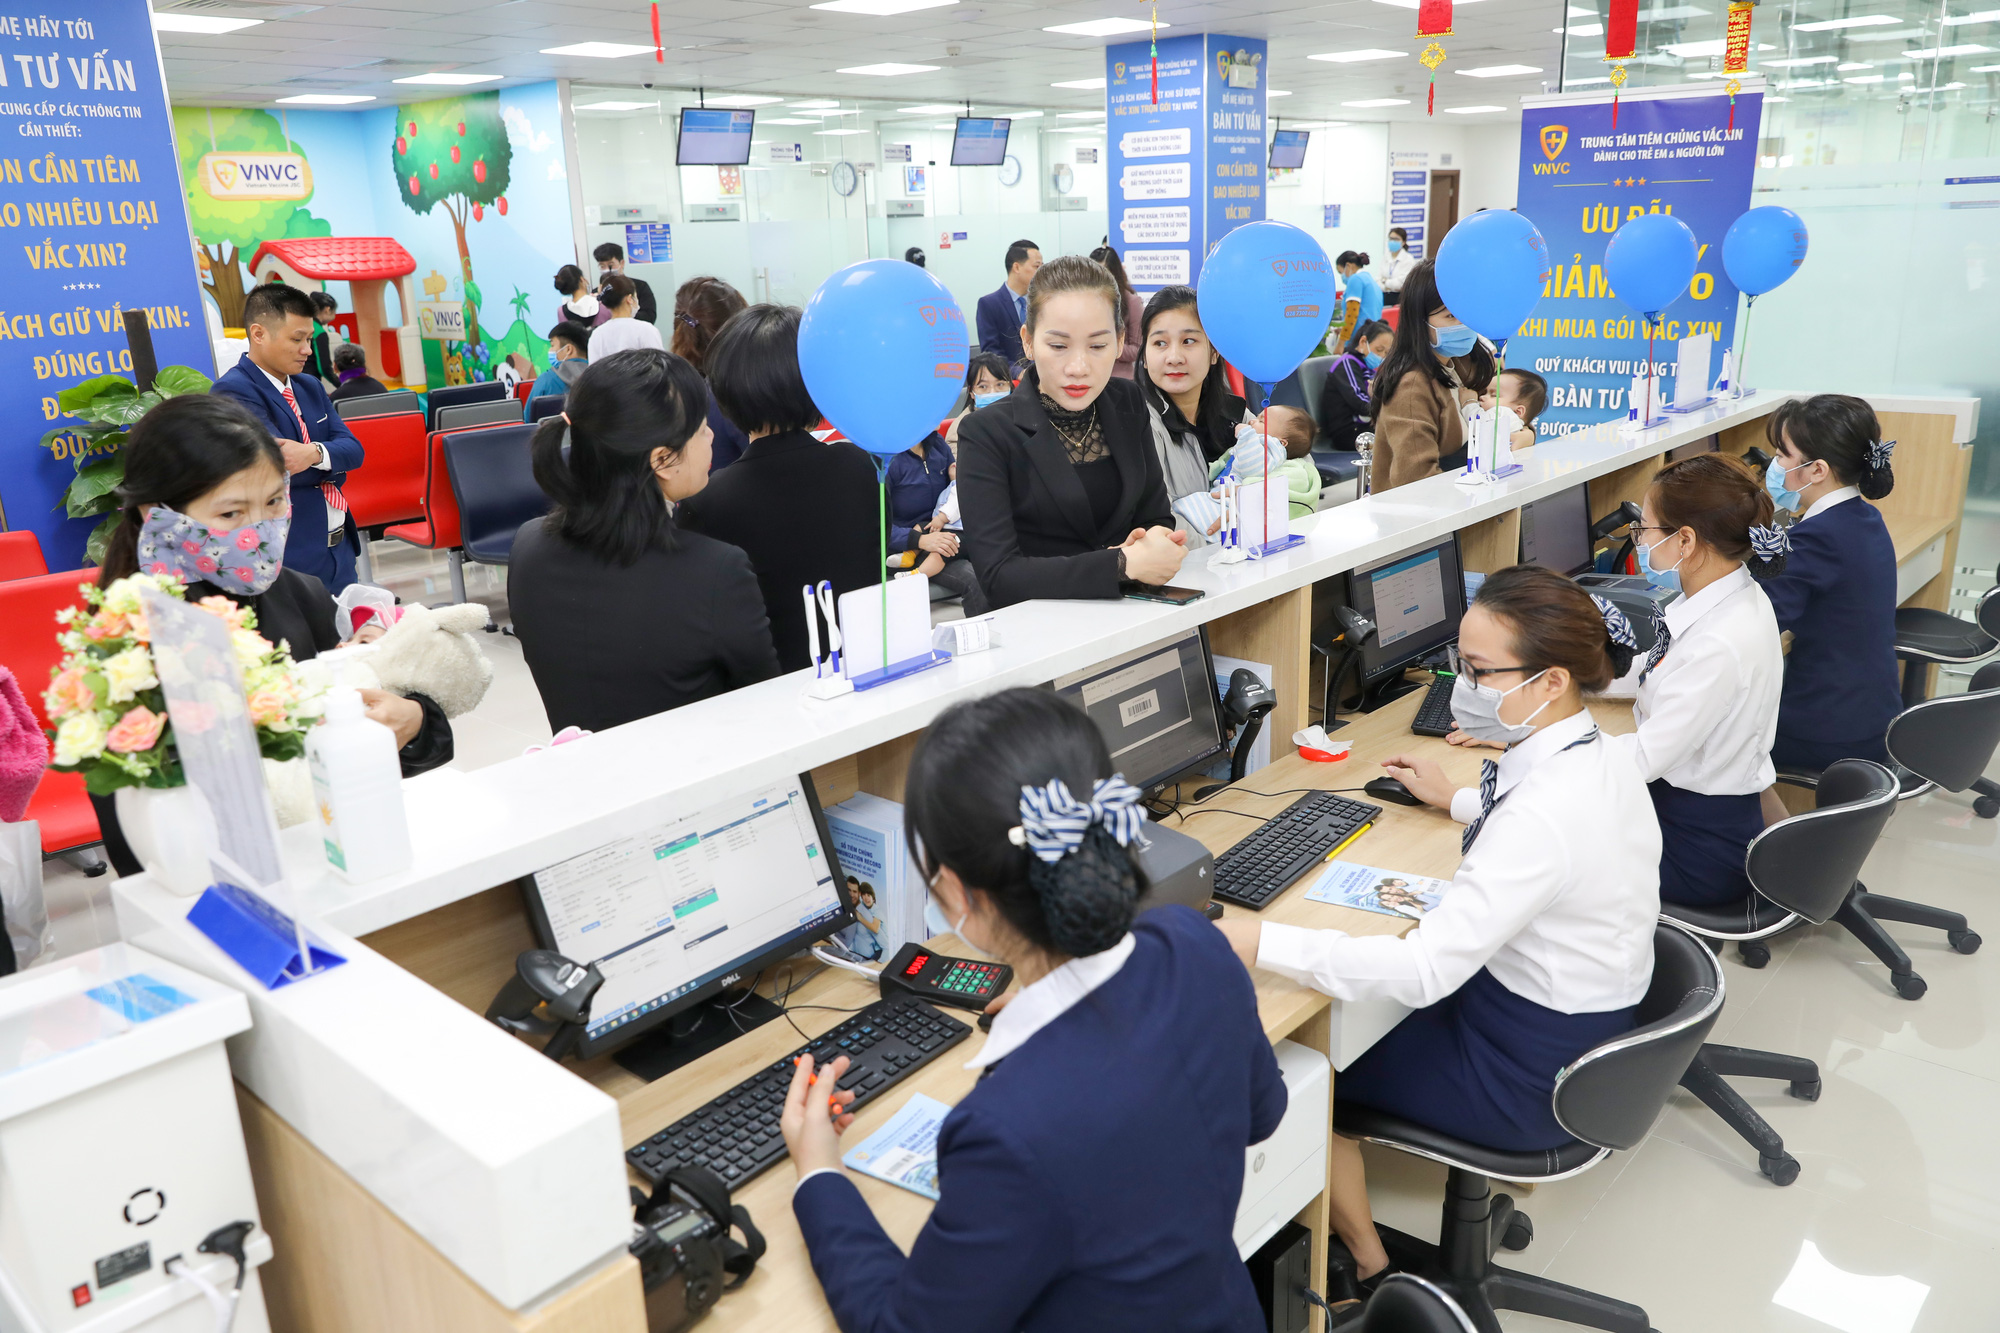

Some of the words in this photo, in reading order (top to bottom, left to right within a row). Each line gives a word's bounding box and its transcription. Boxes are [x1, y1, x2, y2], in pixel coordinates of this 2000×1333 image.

[24, 15, 60, 38] HÃY
[63, 17, 95, 40] TỚI
[13, 52, 60, 89] TƯ
[67, 49, 137, 92] VẤN
[0, 102, 32, 116] CUNG
[34, 100, 57, 117] CẤP
[59, 102, 81, 117] CÁC
[81, 103, 121, 118] THÔNG
[122, 106, 142, 118] TIN
[1128, 106, 1139, 115] XIN
[1182, 101, 1198, 110] VNVC
[18, 121, 43, 137] CẦN
[44, 122, 82, 138] THIẾT:
[1213, 109, 1231, 130] BÀN
[1233, 111, 1244, 130] TƯ
[1245, 109, 1261, 130] VẤN
[1580, 135, 1614, 149] TRUNG
[1615, 133, 1638, 147] TÂM
[1638, 131, 1664, 146] TIÊM
[1664, 128, 1701, 145] CHỦNG
[1702, 126, 1723, 142] VẮC
[1724, 128, 1744, 141] XIN
[1593, 149, 1618, 163] DÀNH
[1619, 149, 1637, 161] CHO
[1637, 146, 1653, 160] TRẺ
[1654, 148, 1668, 160] EM
[1676, 144, 1706, 158] NGƯỜI
[1706, 145, 1725, 157] LỚN
[0, 158, 23, 183] N
[28, 152, 79, 183] CẦN
[81, 154, 141, 183] TIÊM
[239, 164, 298, 181] VNVC
[1532, 162, 1571, 176] VNVC
[1214, 185, 1227, 199] BAO
[0, 202, 21, 227] O
[107, 201, 159, 231] LOẠI
[1581, 202, 1620, 234] ƯU
[24, 237, 73, 270] VẮC
[75, 242, 127, 268] XIN?
[1290, 260, 1326, 273] VNVC
[49, 306, 91, 337] GIỮ
[95, 301, 140, 333] VẮ
[147, 305, 190, 330] XIN:
[433, 311, 461, 326] VNVC
[1518, 318, 1548, 338] KHI
[1553, 319, 1597, 339] MUA
[1602, 315, 1636, 340] GÓI
[1641, 313, 1681, 341] VẮC
[1686, 321, 1722, 342] XIN
[33, 349, 103, 380] ĐÚNG
[1535, 356, 1561, 373] QUÝ
[1563, 356, 1606, 374] KHÁCH
[1609, 360, 1631, 375] VUI
[1633, 359, 1668, 377] LÒNG
[1552, 383, 1594, 409] BÀN
[1598, 387, 1625, 411] TƯ
[1540, 421, 1573, 436] ĐƯỢC
[721, 972, 741, 987] DELL
